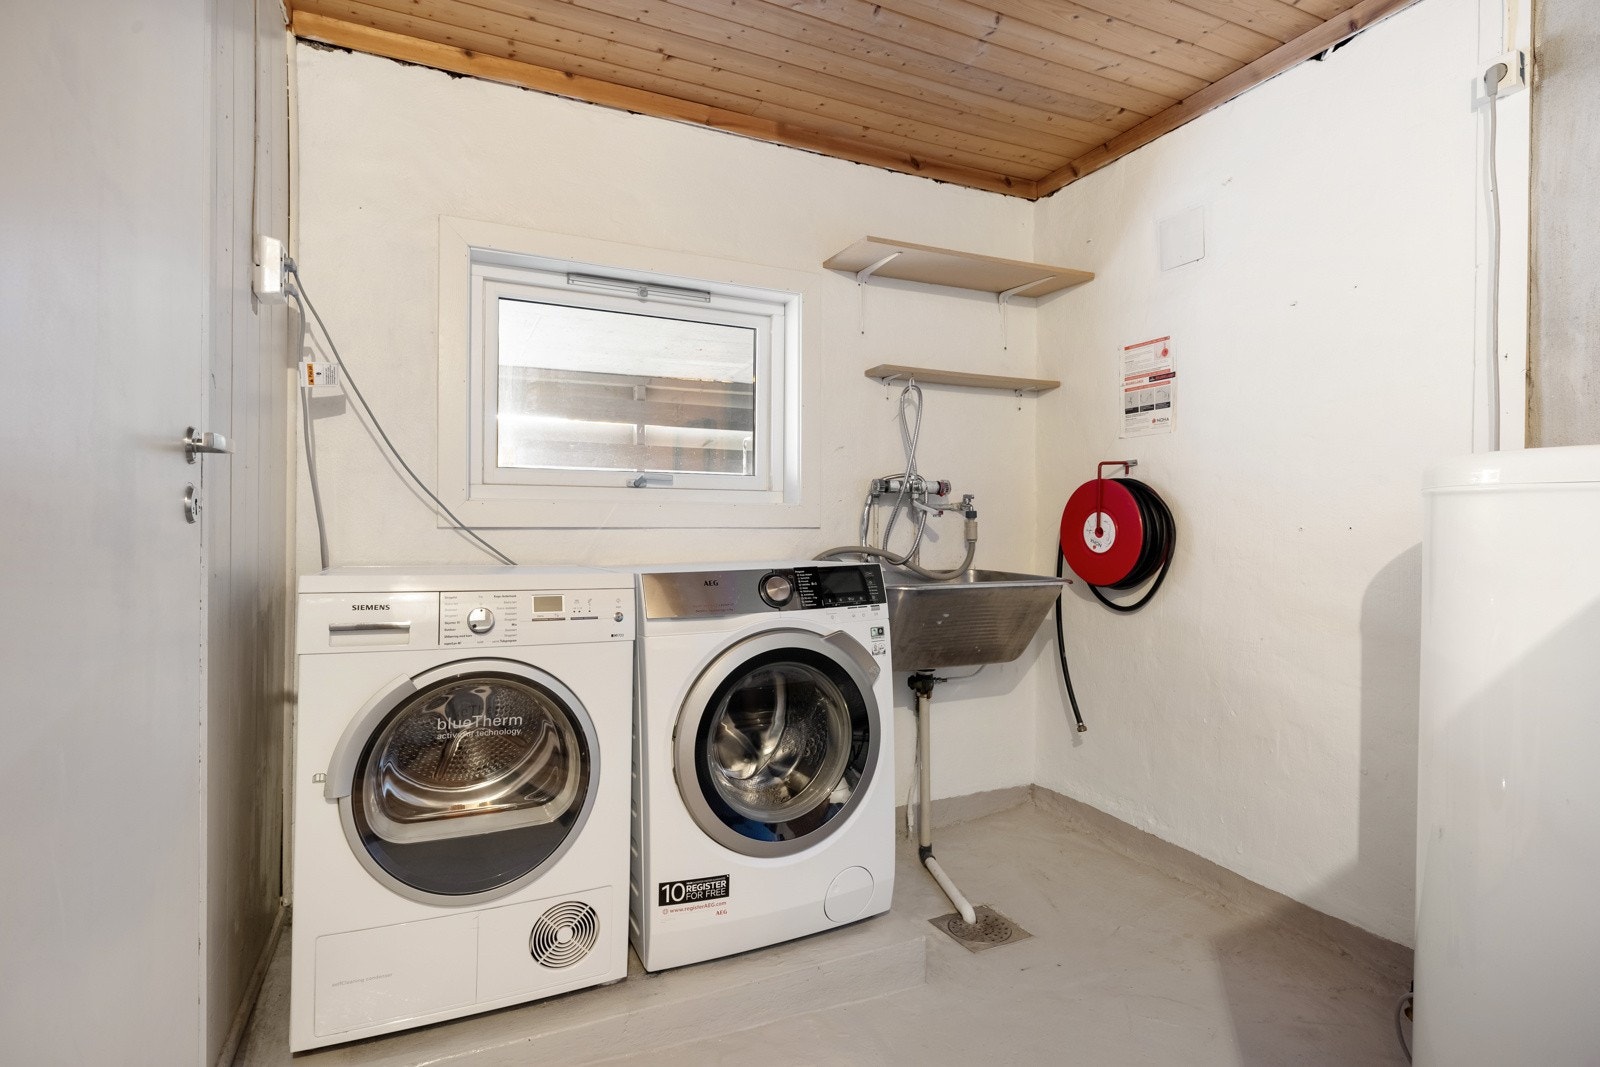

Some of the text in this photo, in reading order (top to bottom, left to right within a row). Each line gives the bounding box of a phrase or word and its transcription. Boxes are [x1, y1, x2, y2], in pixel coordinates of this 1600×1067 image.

[703, 579, 719, 587] AEG
[437, 715, 523, 730] blueTherm
[436, 731, 462, 740] activ
[476, 728, 522, 737] technology
[661, 882, 686, 903] 10
[686, 880, 727, 893] REGISTER
[686, 887, 726, 900] FOR FREE
[669, 901, 727, 914] www.registerAEG.com
